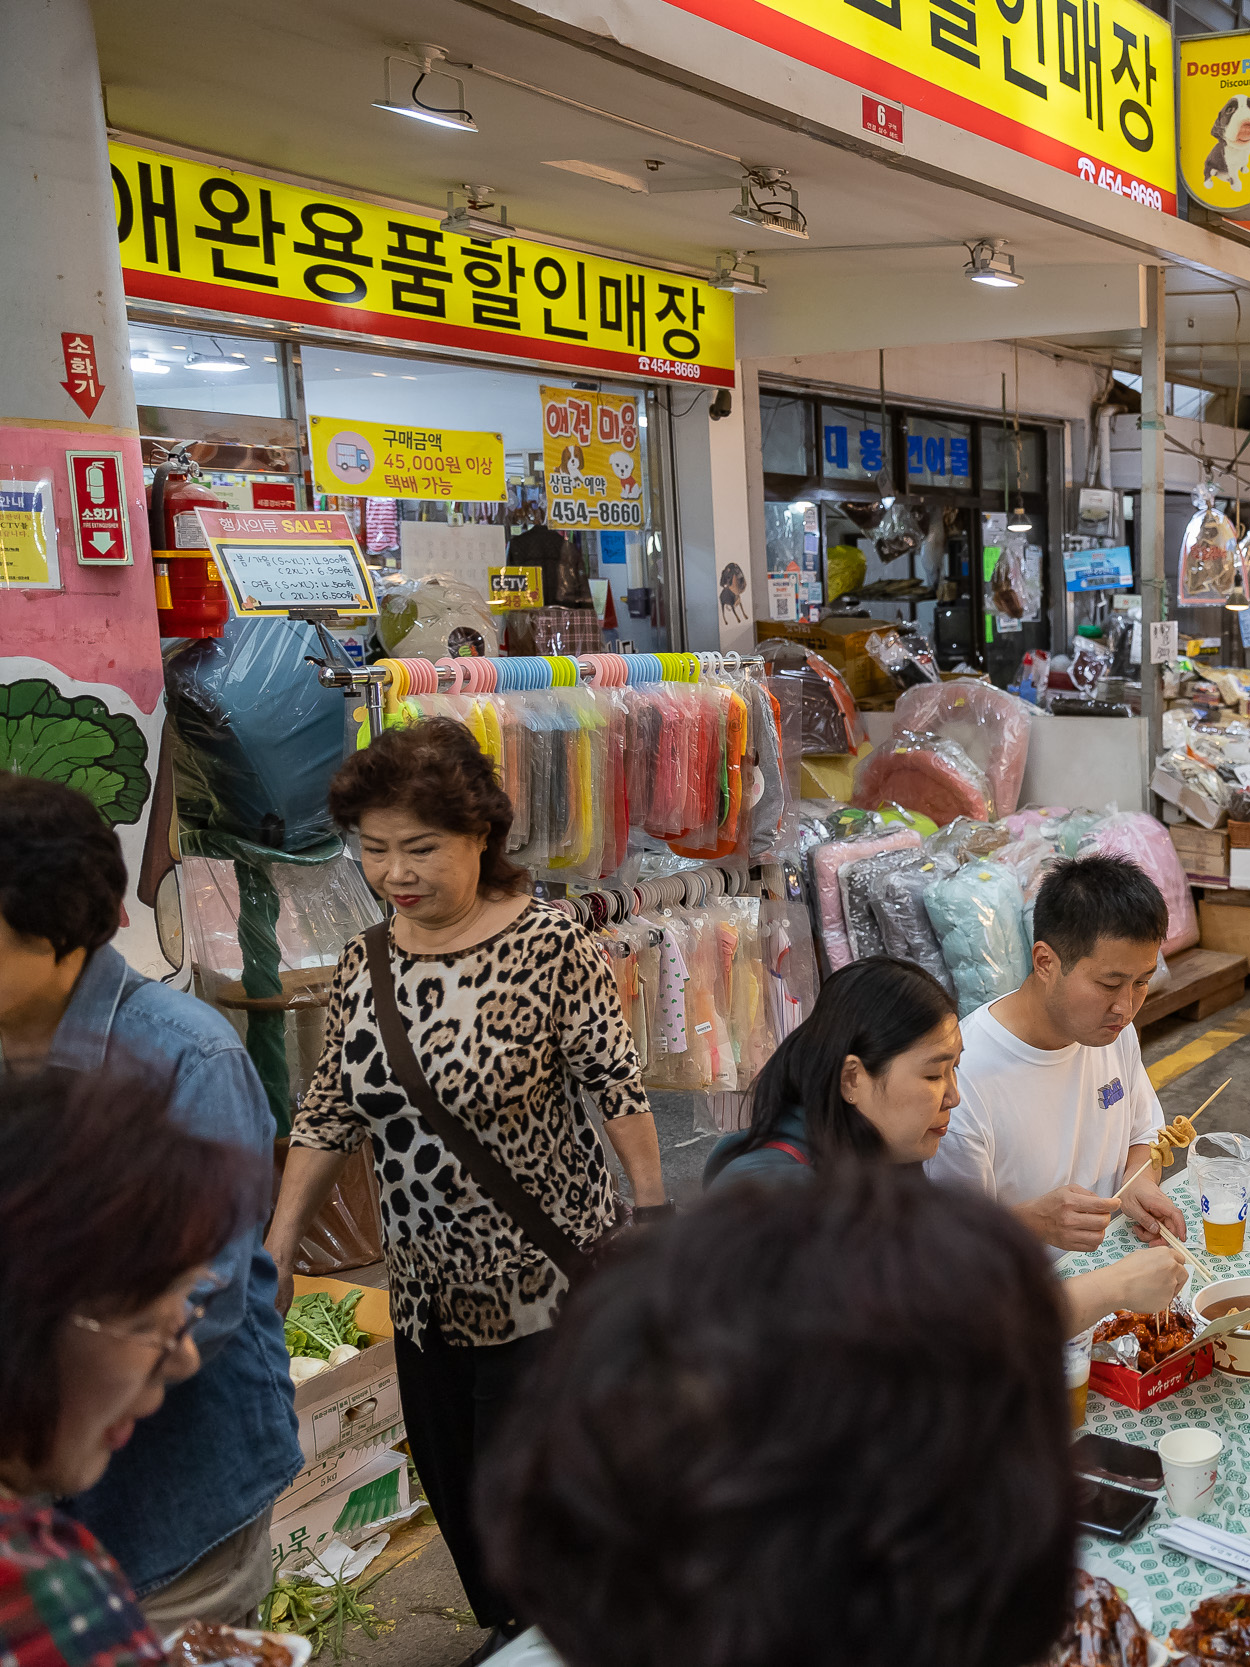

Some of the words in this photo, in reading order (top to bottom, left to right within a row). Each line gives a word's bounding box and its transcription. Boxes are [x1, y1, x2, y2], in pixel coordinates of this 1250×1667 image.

[877, 105, 886, 126] 6
[68, 337, 95, 397] 소화기
[650, 358, 700, 378] 454-8669
[545, 396, 592, 446] 애견
[598, 402, 637, 452] 미용
[383, 429, 442, 452] 구매금액
[384, 453, 461, 474] 45,000원
[466, 457, 493, 476] 이상
[385, 474, 418, 493] 택배
[422, 477, 453, 496] 가능
[82, 508, 118, 521] 소화기
[552, 500, 642, 524] 454-8660
[219, 517, 279, 534] 행사의류
[281, 519, 332, 533] SALE!
[493, 577, 525, 589] CCTV
